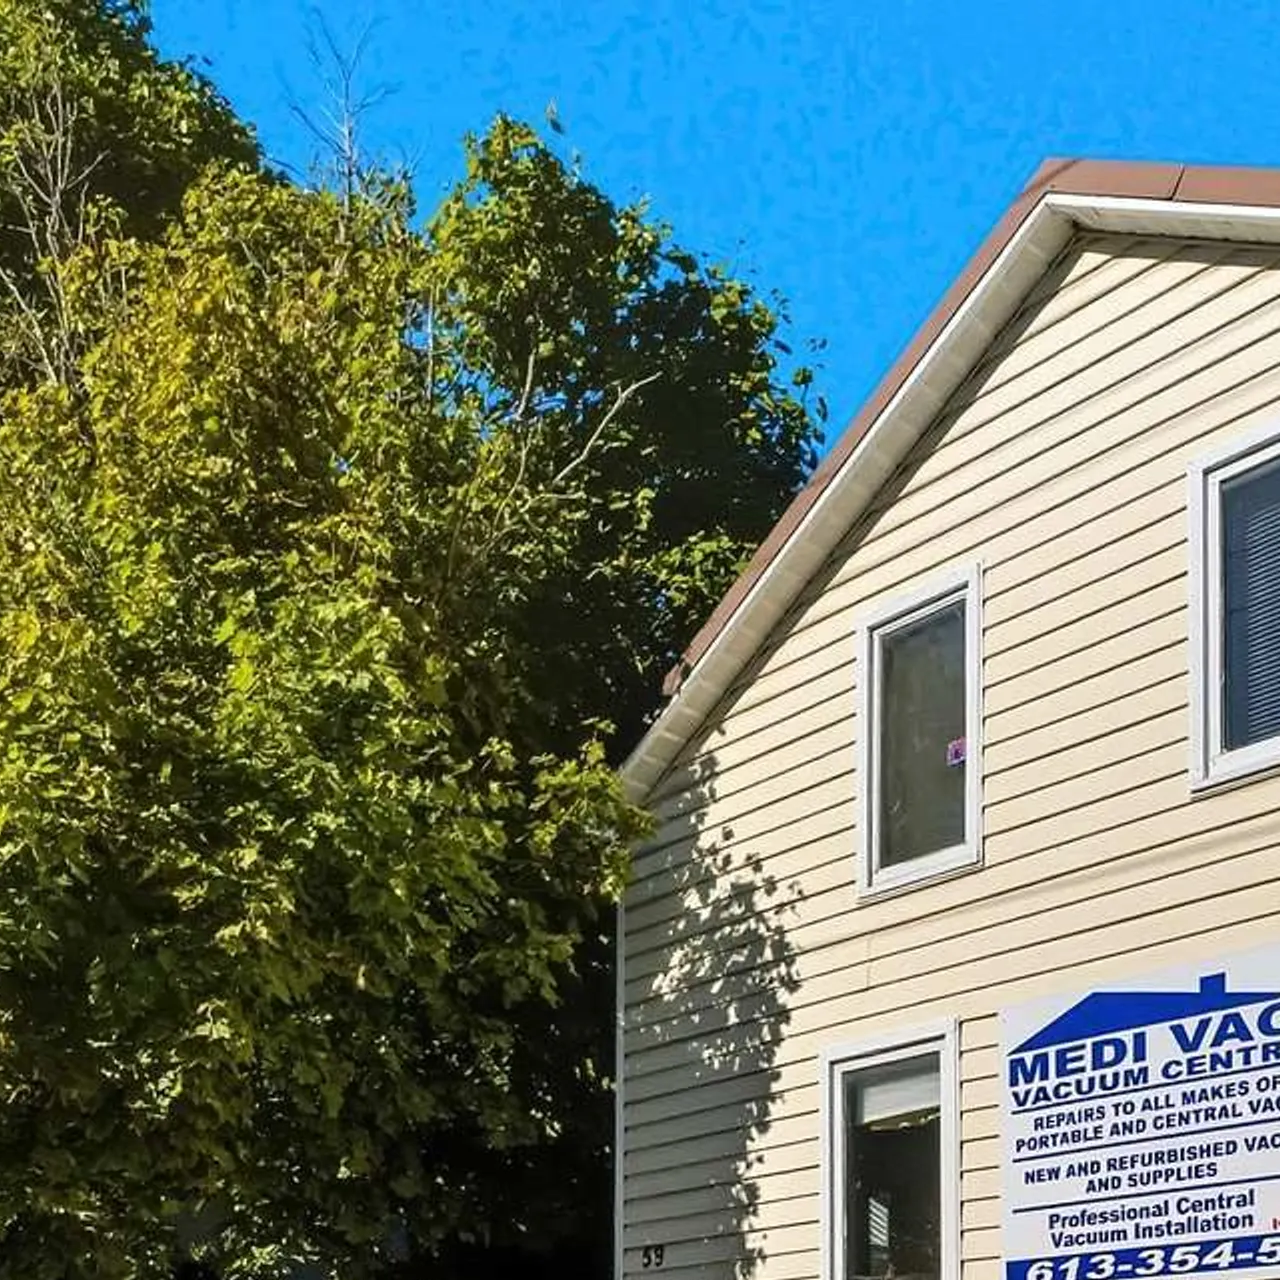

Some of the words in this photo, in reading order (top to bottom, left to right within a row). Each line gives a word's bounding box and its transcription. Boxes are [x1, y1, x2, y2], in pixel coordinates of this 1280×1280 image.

[1009, 1032, 1147, 1088] MEDI
[1012, 1066, 1149, 1107] VACUUM
[1033, 1105, 1106, 1131] REPAIRS
[1111, 1100, 1135, 1117] TO
[1141, 1093, 1175, 1112] ALL
[1181, 1080, 1250, 1106] MAKES
[1016, 1125, 1104, 1153] PORTABLE
[1109, 1119, 1147, 1137] AND
[1152, 1102, 1243, 1131] CENTRAL
[1024, 1166, 1061, 1185] NEW
[1065, 1160, 1101, 1179] AND
[1106, 1139, 1238, 1173] REFURBISHED
[1086, 1176, 1122, 1194] AND
[1127, 1162, 1218, 1188] SUPPLIES
[1048, 1200, 1170, 1231] Professional
[1176, 1188, 1255, 1215] Central
[1050, 1227, 1128, 1249] Vacuum
[1134, 1211, 1254, 1240] Installation
